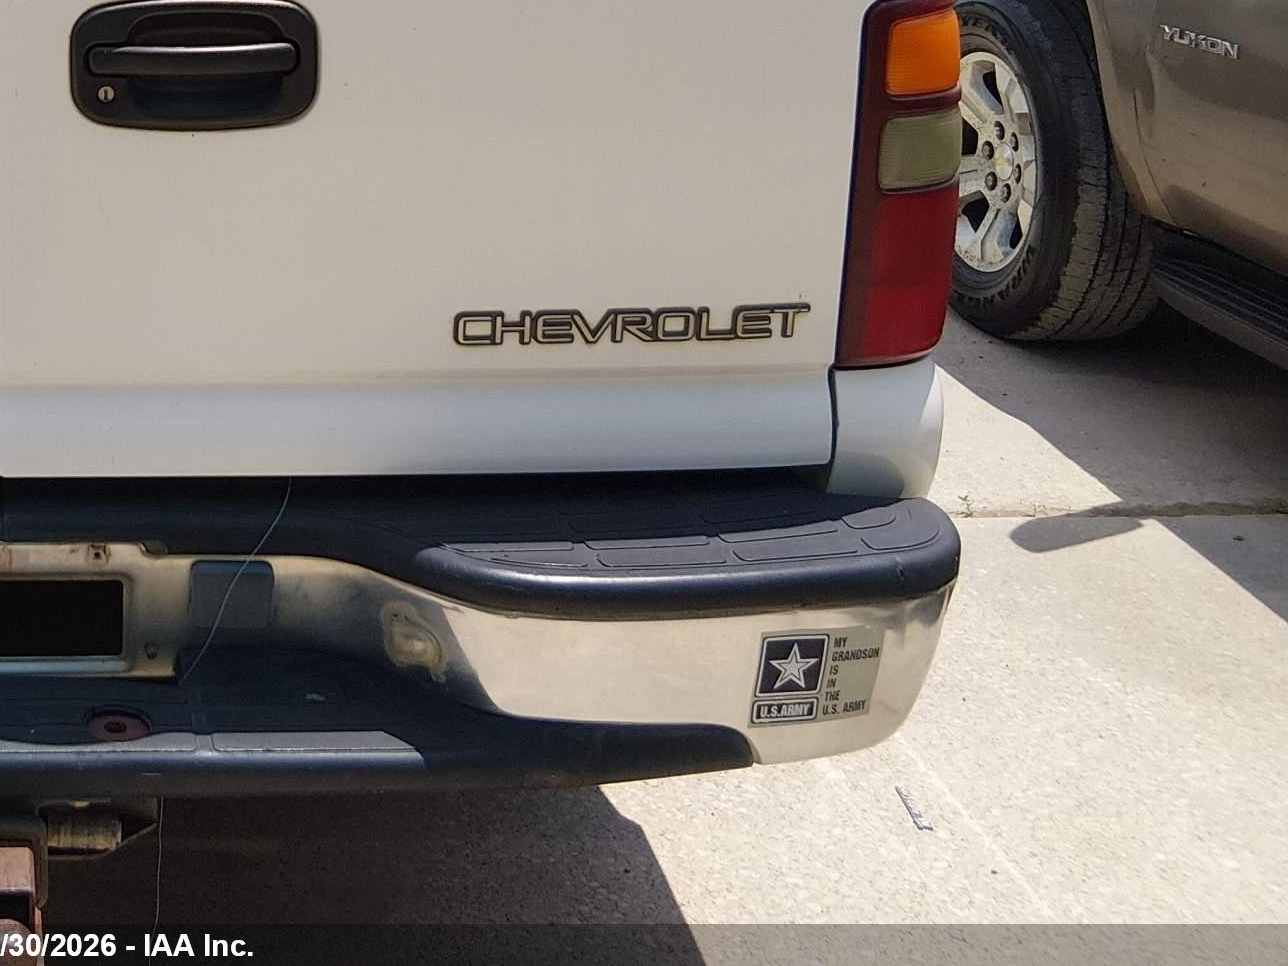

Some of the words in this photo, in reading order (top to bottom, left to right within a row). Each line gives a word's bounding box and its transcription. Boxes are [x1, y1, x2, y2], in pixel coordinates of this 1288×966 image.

[1159, 24, 1240, 59] YUKON
[455, 304, 810, 346] CHEVROLET
[834, 637, 848, 648] MY
[831, 647, 880, 662] GRANDSON
[829, 665, 839, 675] IS
[826, 678, 837, 688] IN
[824, 690, 840, 701] THE
[822, 704, 839, 715] U.S.
[843, 701, 867, 713] ARMY
